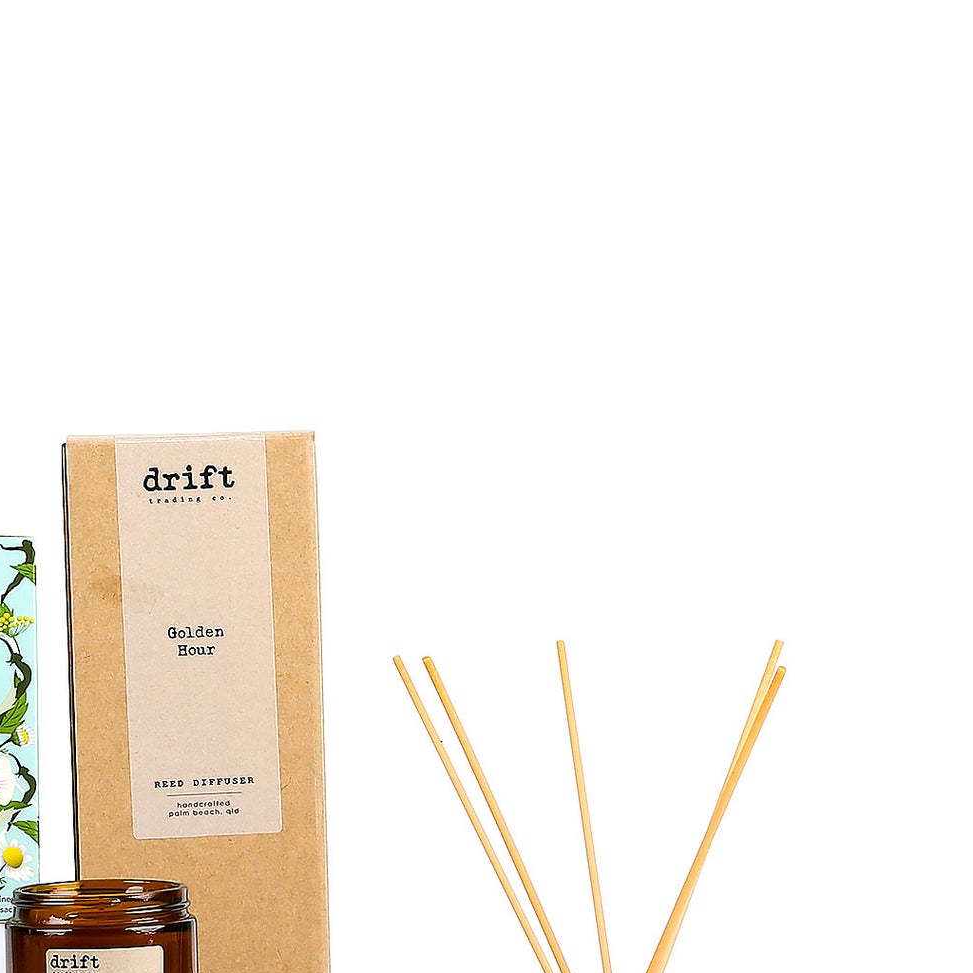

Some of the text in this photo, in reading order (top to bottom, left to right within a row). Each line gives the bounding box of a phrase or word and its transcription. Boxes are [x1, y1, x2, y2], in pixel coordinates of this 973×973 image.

[143, 464, 235, 492] drift
[148, 494, 232, 505] trading co.
[167, 625, 225, 639] Golden
[177, 644, 216, 657] Hour
[154, 776, 255, 789] REED DIFFUSER
[176, 799, 231, 809] handcrafted
[168, 809, 190, 818] palm
[225, 807, 240, 816] qld
[50, 953, 100, 969] drift
